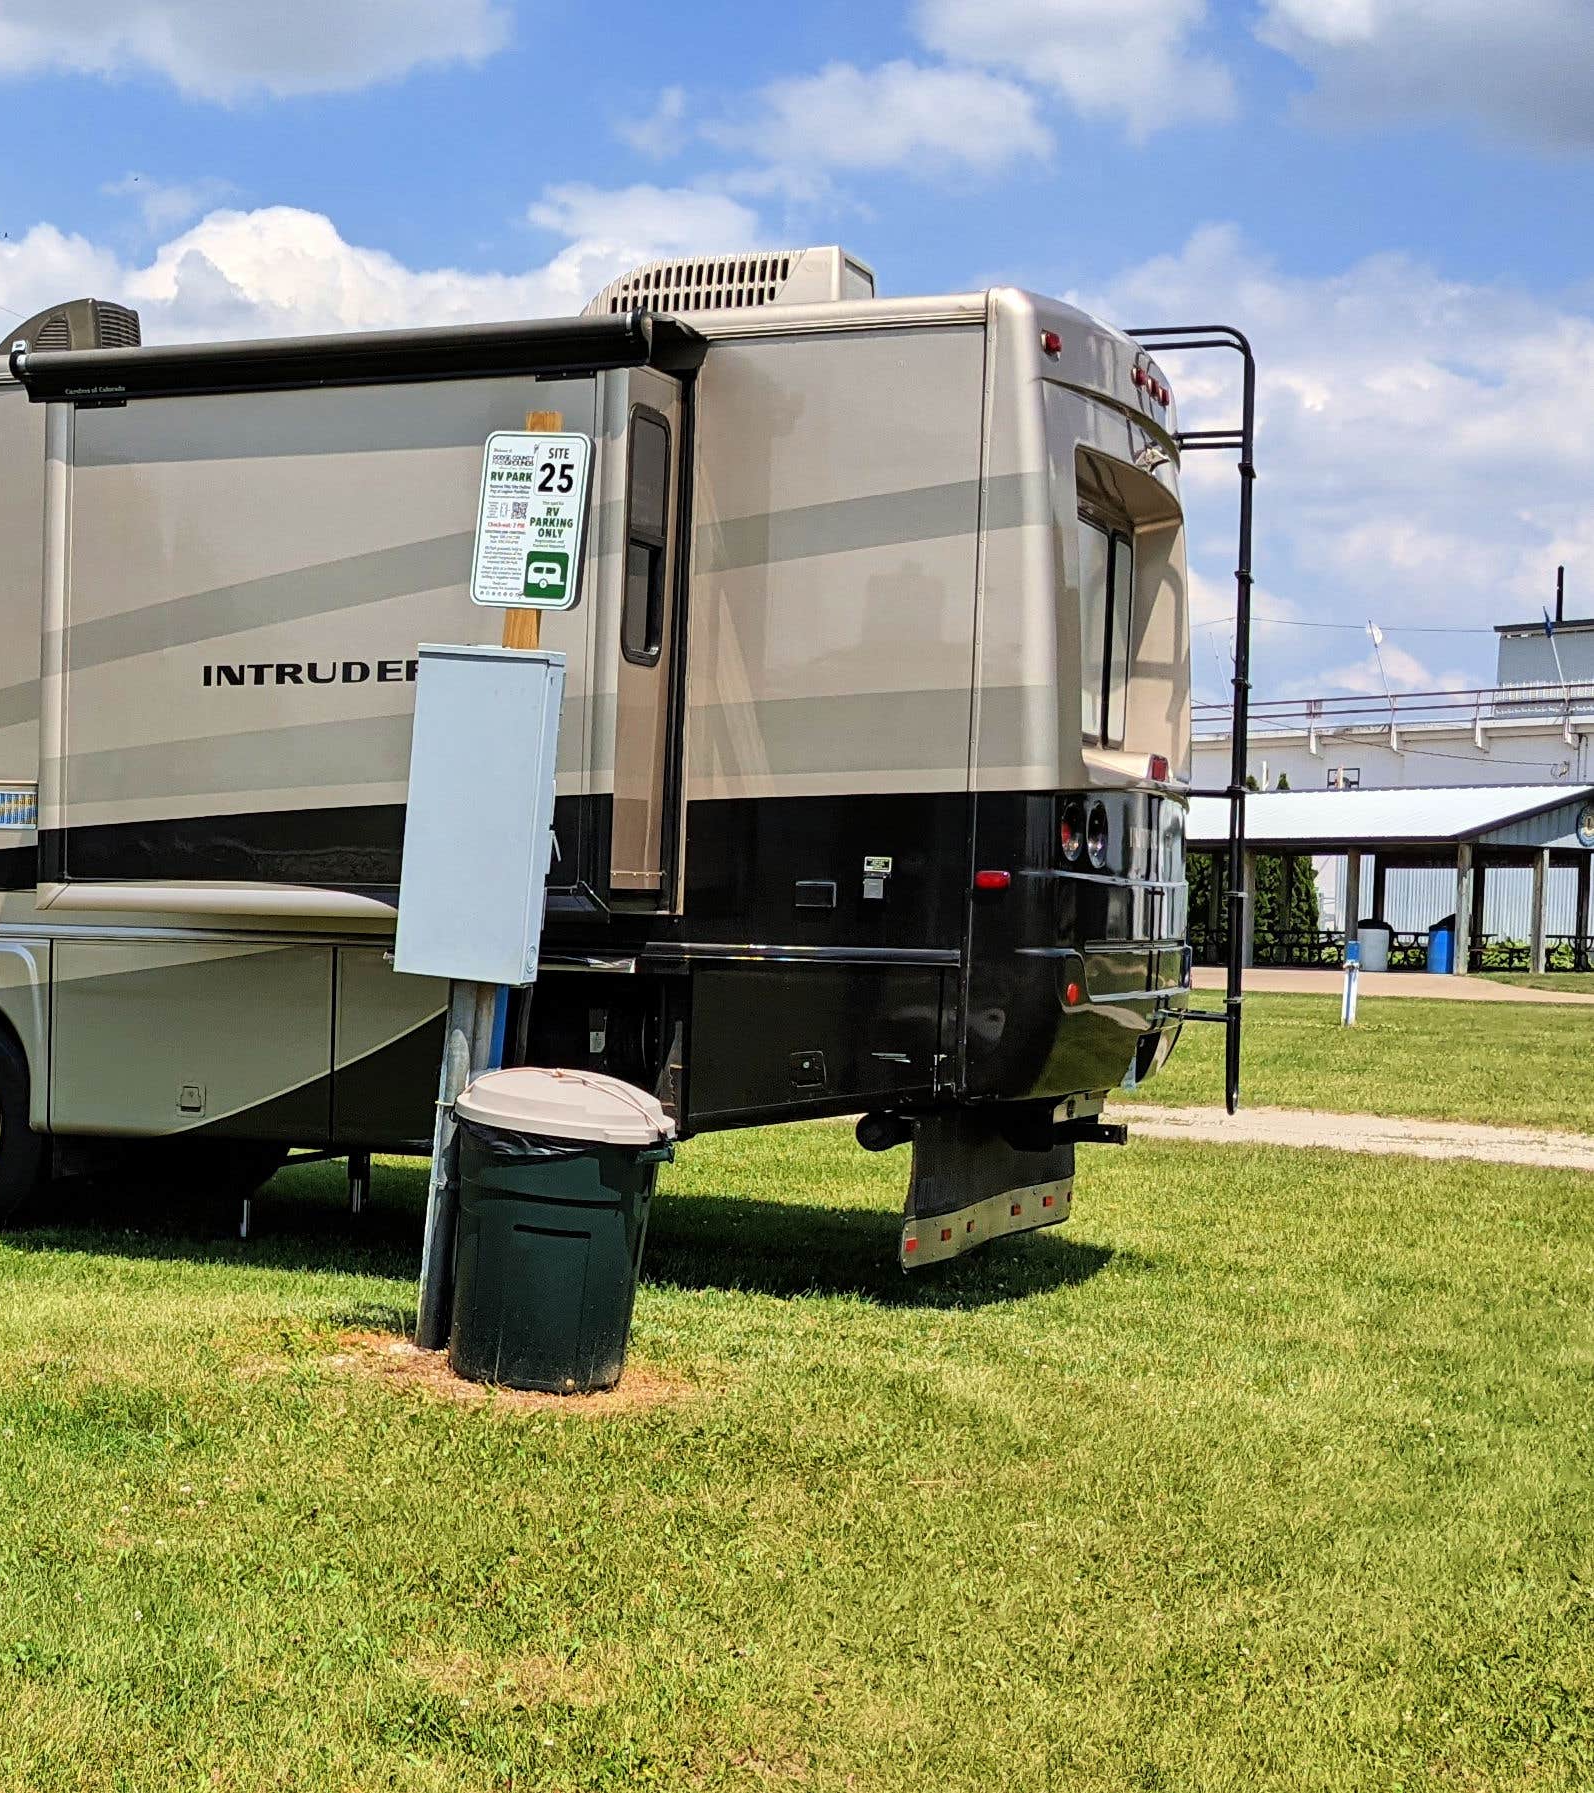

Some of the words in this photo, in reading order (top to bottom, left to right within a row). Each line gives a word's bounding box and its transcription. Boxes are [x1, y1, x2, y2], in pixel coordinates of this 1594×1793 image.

[548, 447, 570, 459] SITE
[490, 471, 505, 481] RV
[505, 472, 533, 482] PARK
[537, 463, 575, 493] 25
[546, 507, 561, 517] RV
[529, 517, 574, 528] PARKING
[538, 528, 564, 539] ONLY
